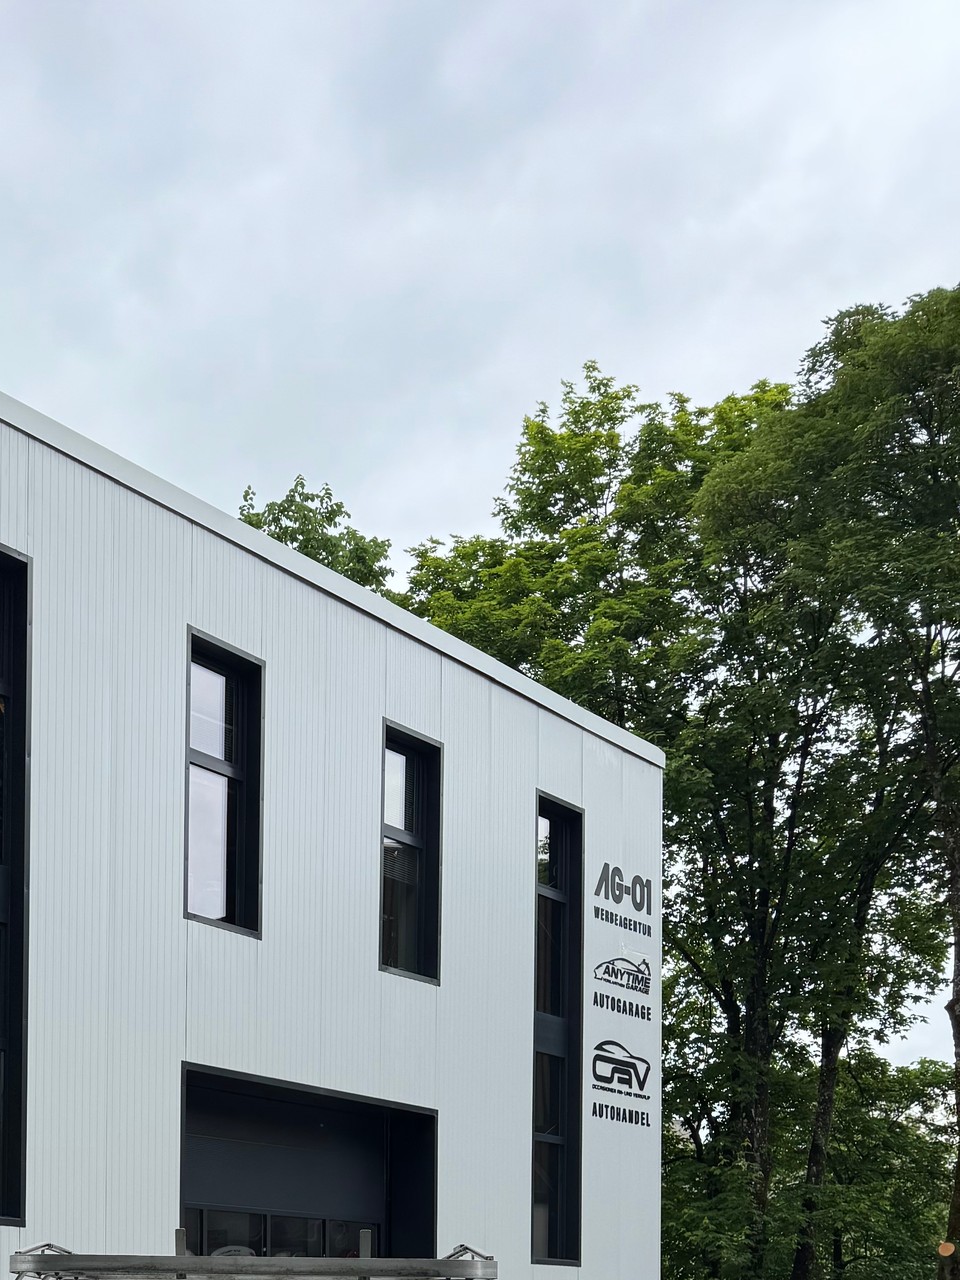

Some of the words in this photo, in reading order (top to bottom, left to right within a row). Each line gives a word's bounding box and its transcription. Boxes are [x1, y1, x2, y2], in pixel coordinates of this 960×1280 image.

[594, 862, 652, 916] AG-01
[593, 905, 652, 938] WERBEAGENTUR
[602, 964, 651, 988] ANYTIME
[625, 982, 650, 995] GARAGE
[593, 991, 652, 1021] AUTOGARAGE
[591, 1101, 651, 1127] AUTOHANDEL
